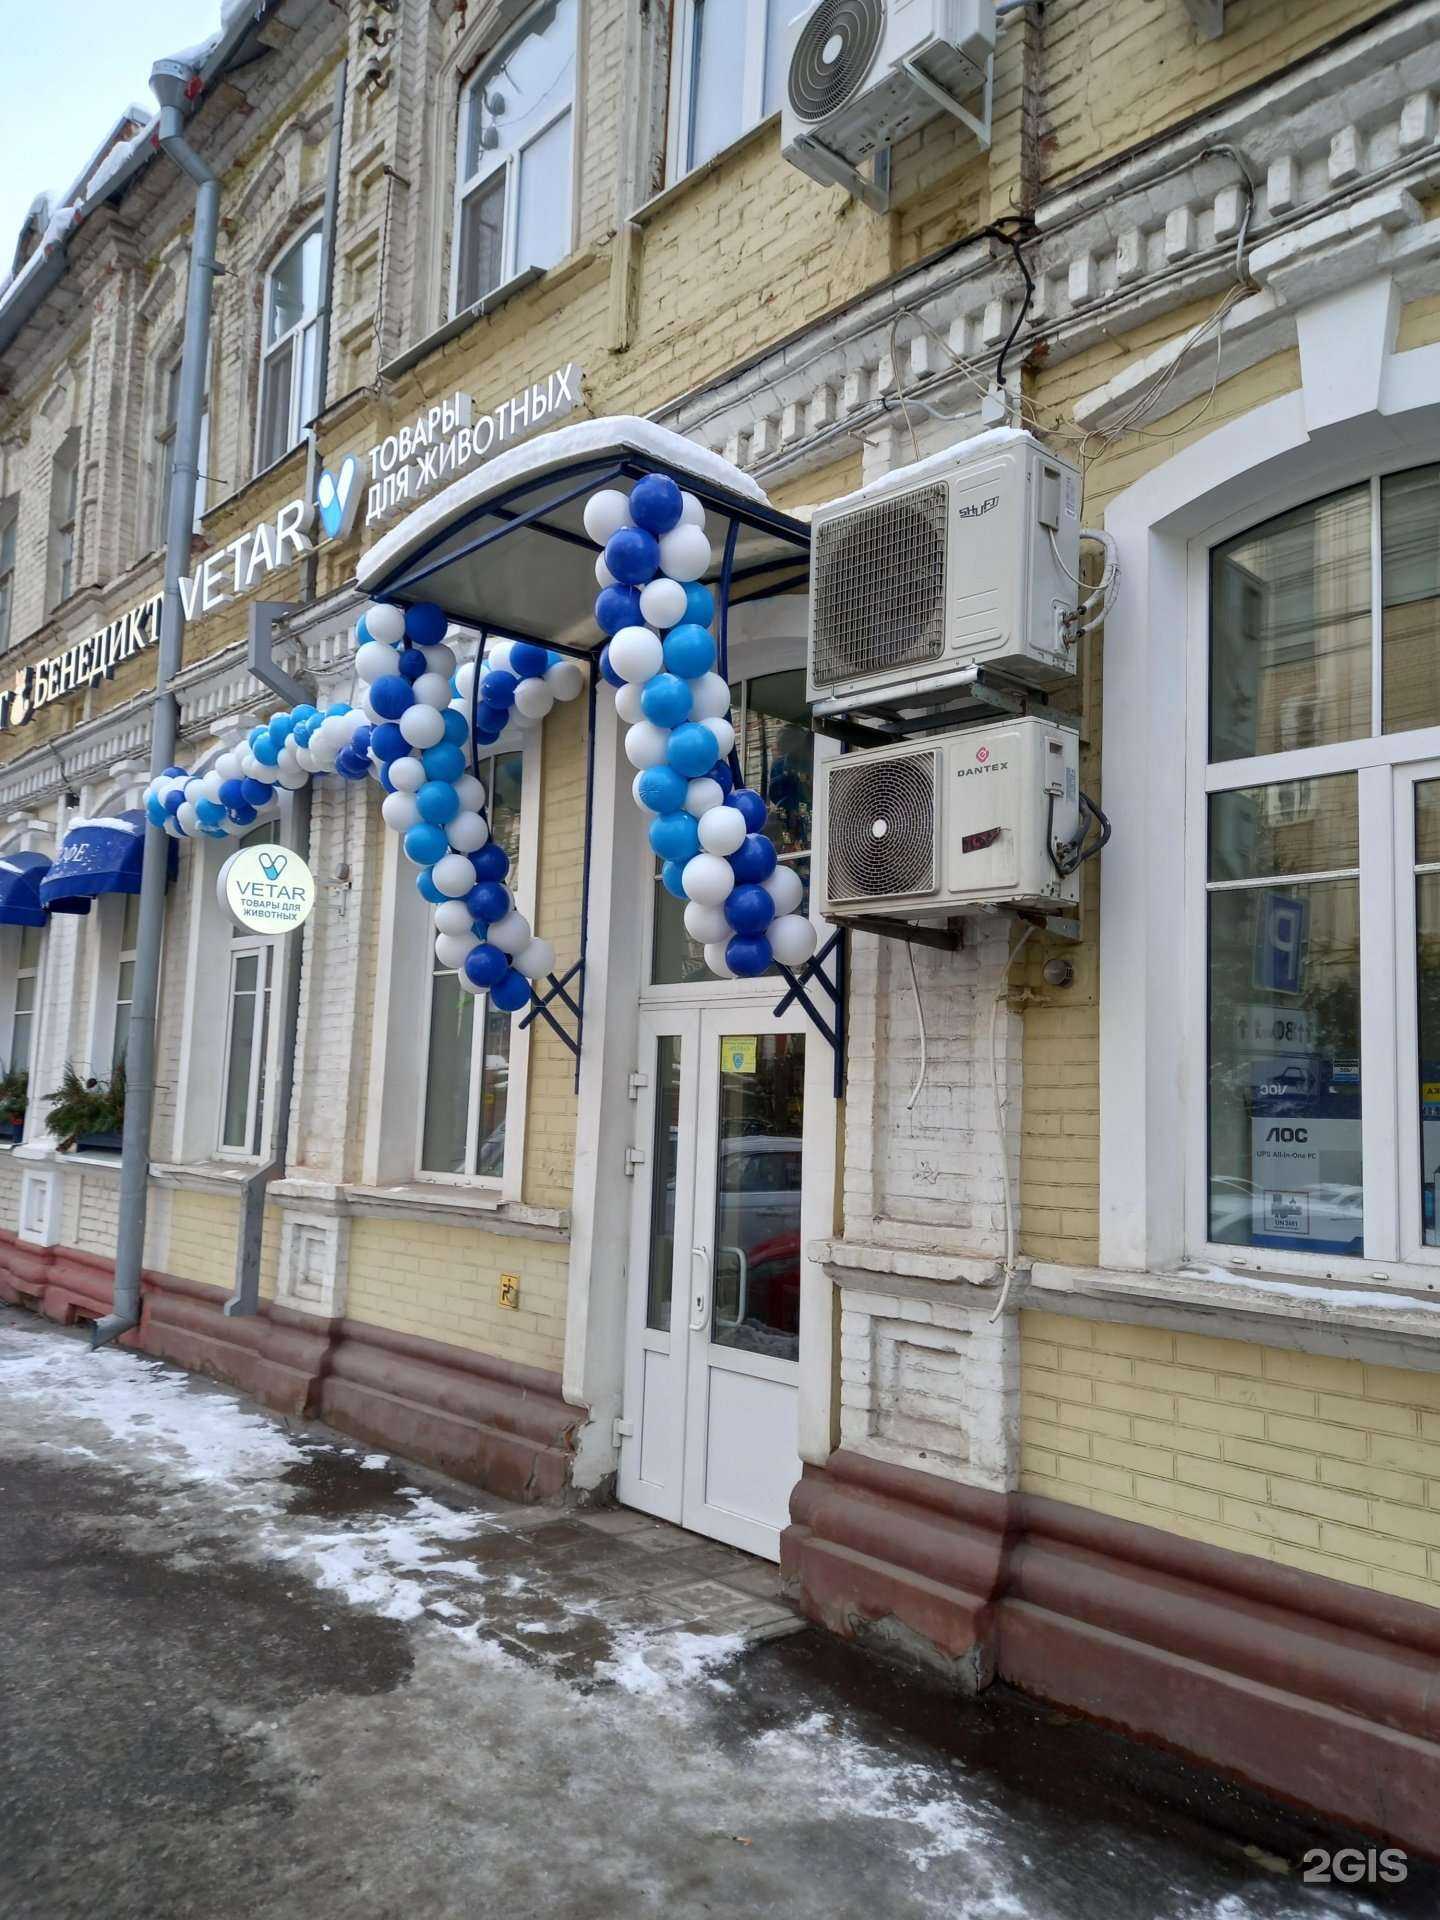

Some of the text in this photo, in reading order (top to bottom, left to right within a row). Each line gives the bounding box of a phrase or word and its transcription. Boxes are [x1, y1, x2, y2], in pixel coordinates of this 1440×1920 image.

[364, 362, 574, 528] ДЛЯ ЖИВОТНЫХ
[368, 391, 462, 478] ТОВАРЫ
[177, 498, 306, 622] VETAR
[33, 590, 165, 709] БЕНЕДИКТ
[957, 761, 1008, 778] DANTEX
[236, 880, 306, 902] VETAR
[241, 898, 301, 912] ТОВАРЫ ДЛЯ
[243, 908, 298, 921] ЖИВОТНЫХ
[1265, 1127, 1308, 1144] AOC
